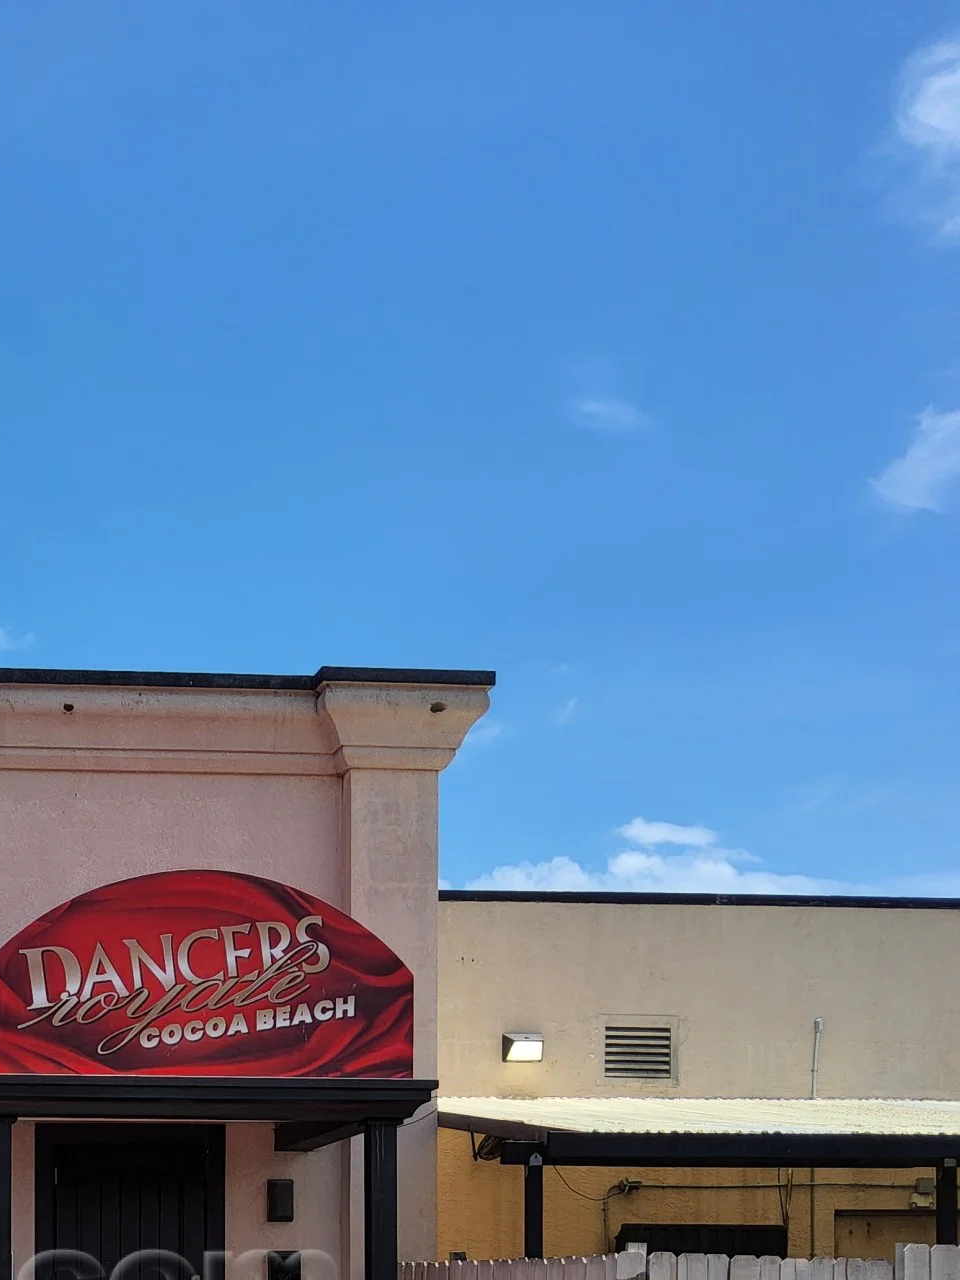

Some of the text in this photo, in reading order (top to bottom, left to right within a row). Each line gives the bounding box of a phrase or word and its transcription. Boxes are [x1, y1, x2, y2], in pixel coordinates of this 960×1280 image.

[17, 940, 318, 1054] royale
[19, 916, 331, 1011] DANCERS
[140, 995, 356, 1048] COCOA BEACH
